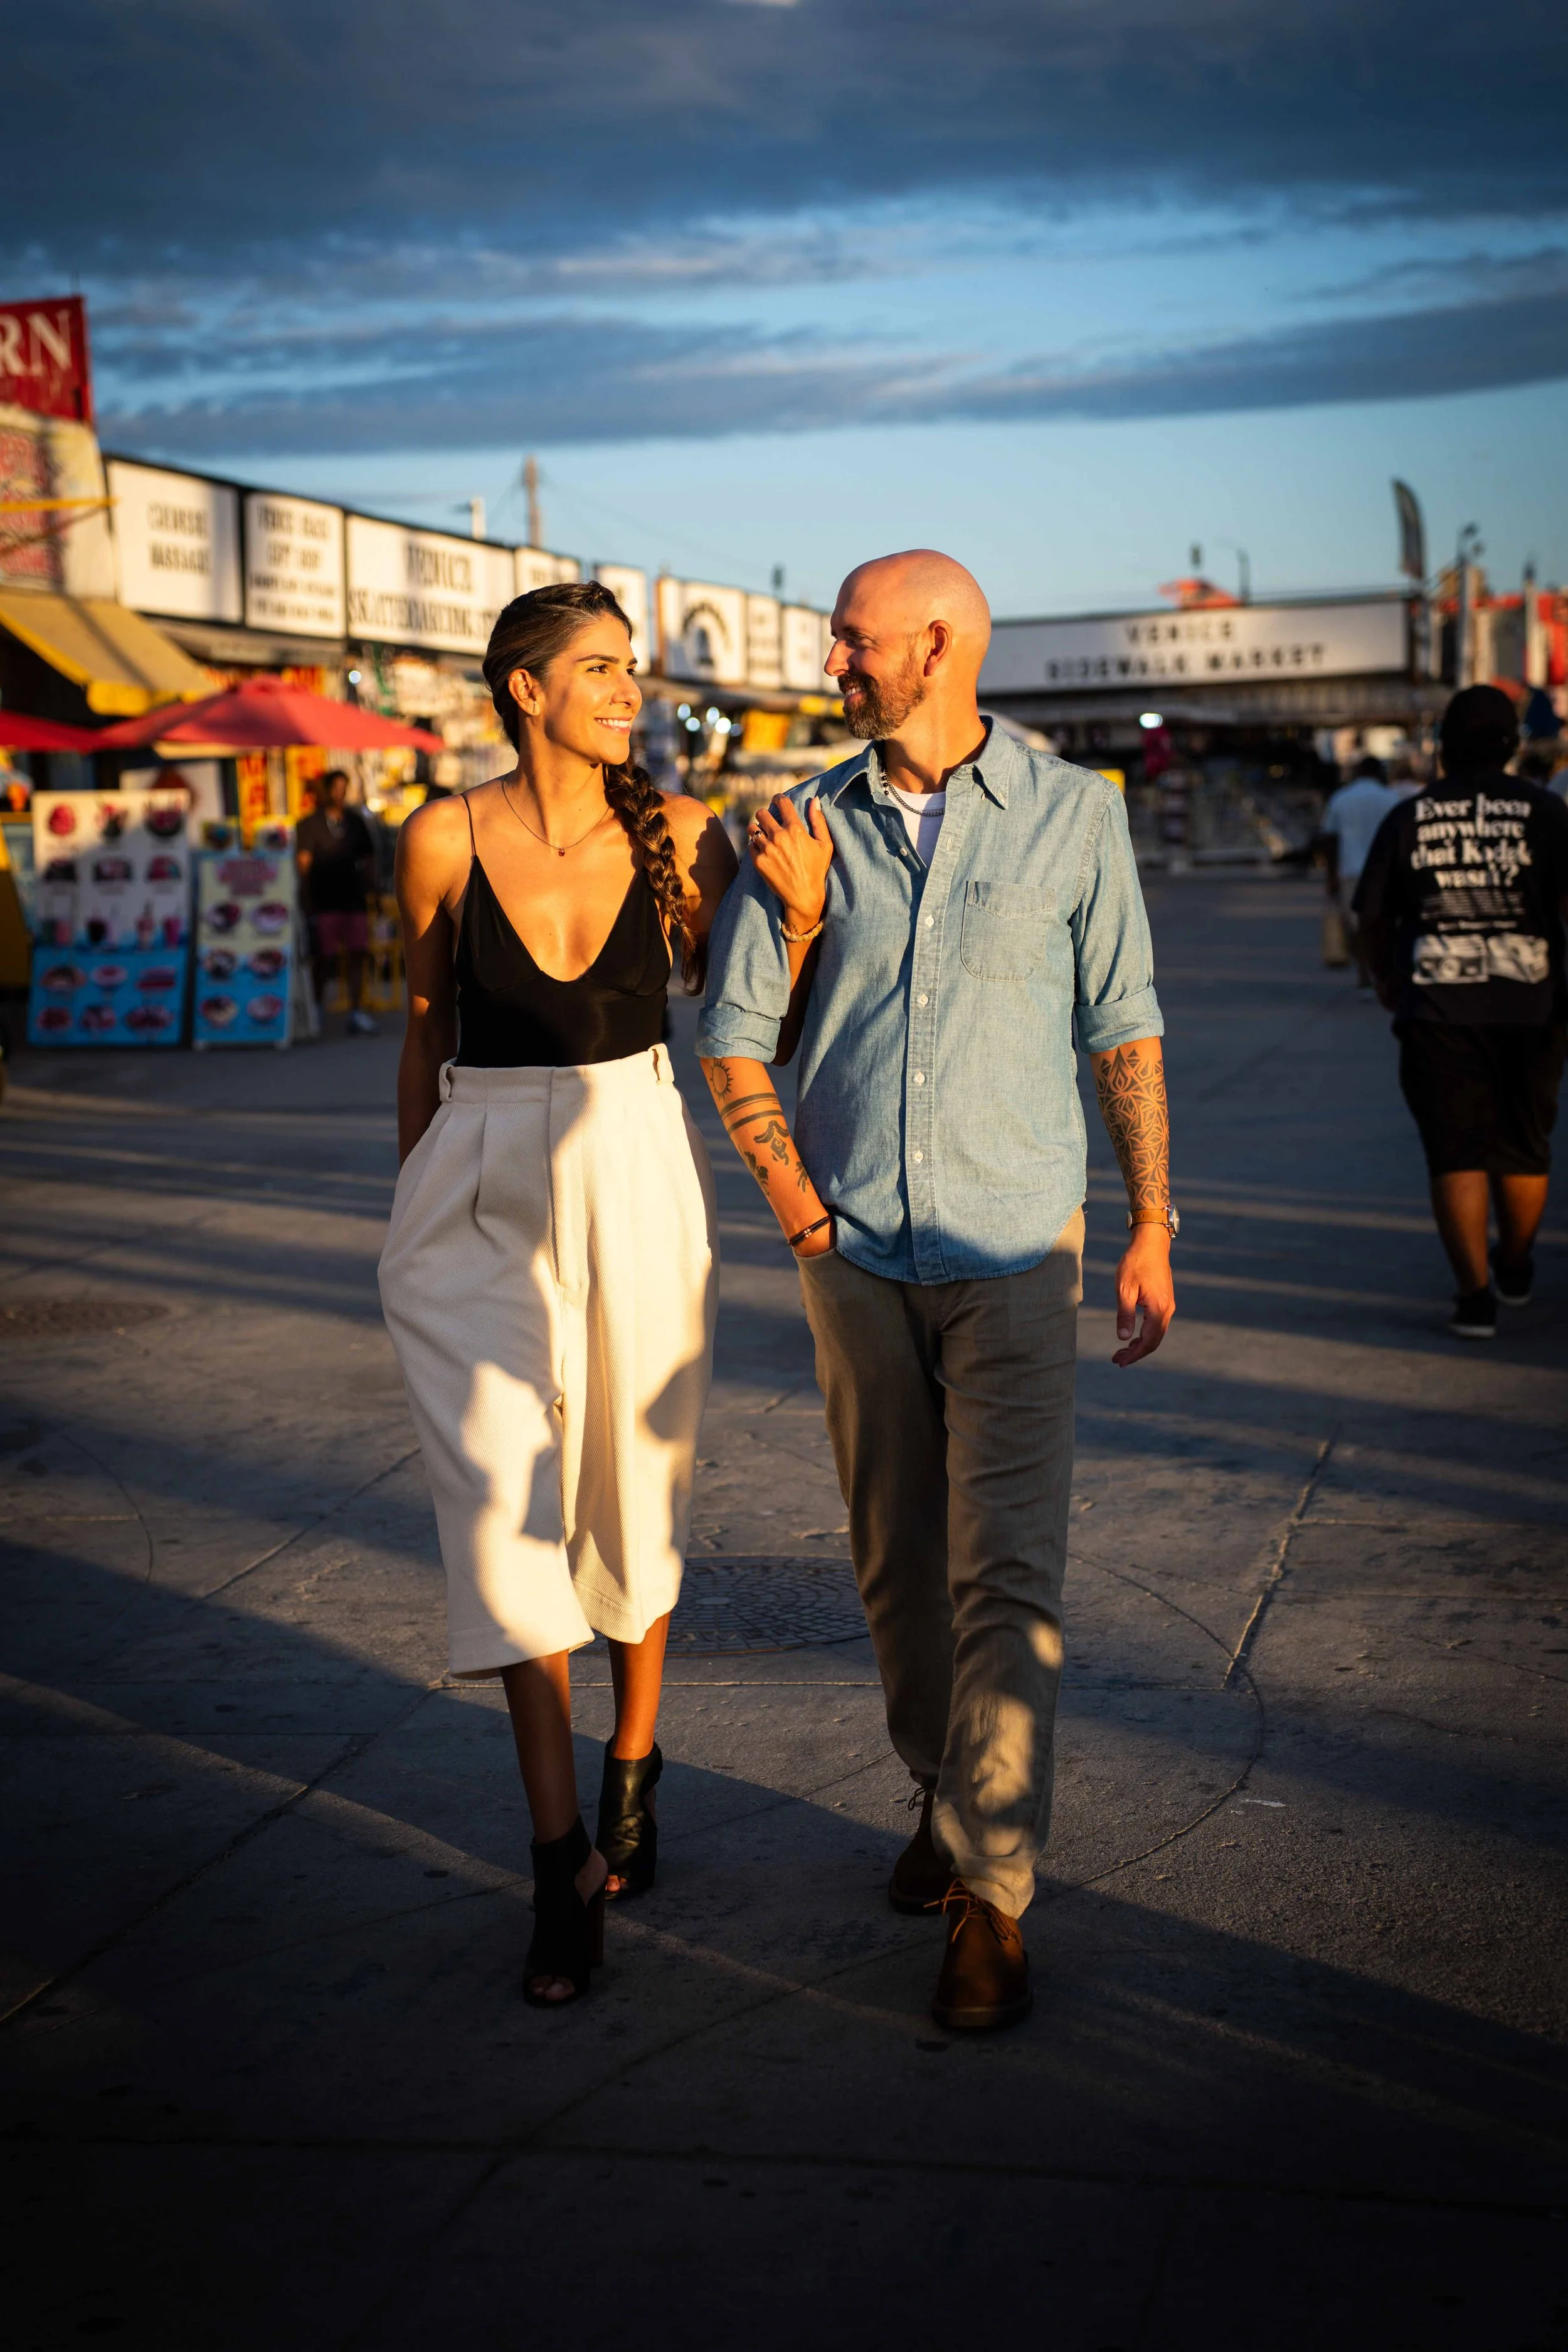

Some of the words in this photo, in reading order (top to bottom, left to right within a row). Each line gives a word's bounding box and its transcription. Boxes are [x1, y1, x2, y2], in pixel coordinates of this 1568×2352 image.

[0, 309, 72, 376] RN
[1124, 620, 1233, 645] VENICE
[1205, 641, 1323, 671] MARKET
[1414, 797, 1473, 822] Ever
[1476, 792, 1532, 818] been
[1416, 815, 1525, 846] anywhere
[1411, 843, 1457, 870] that
